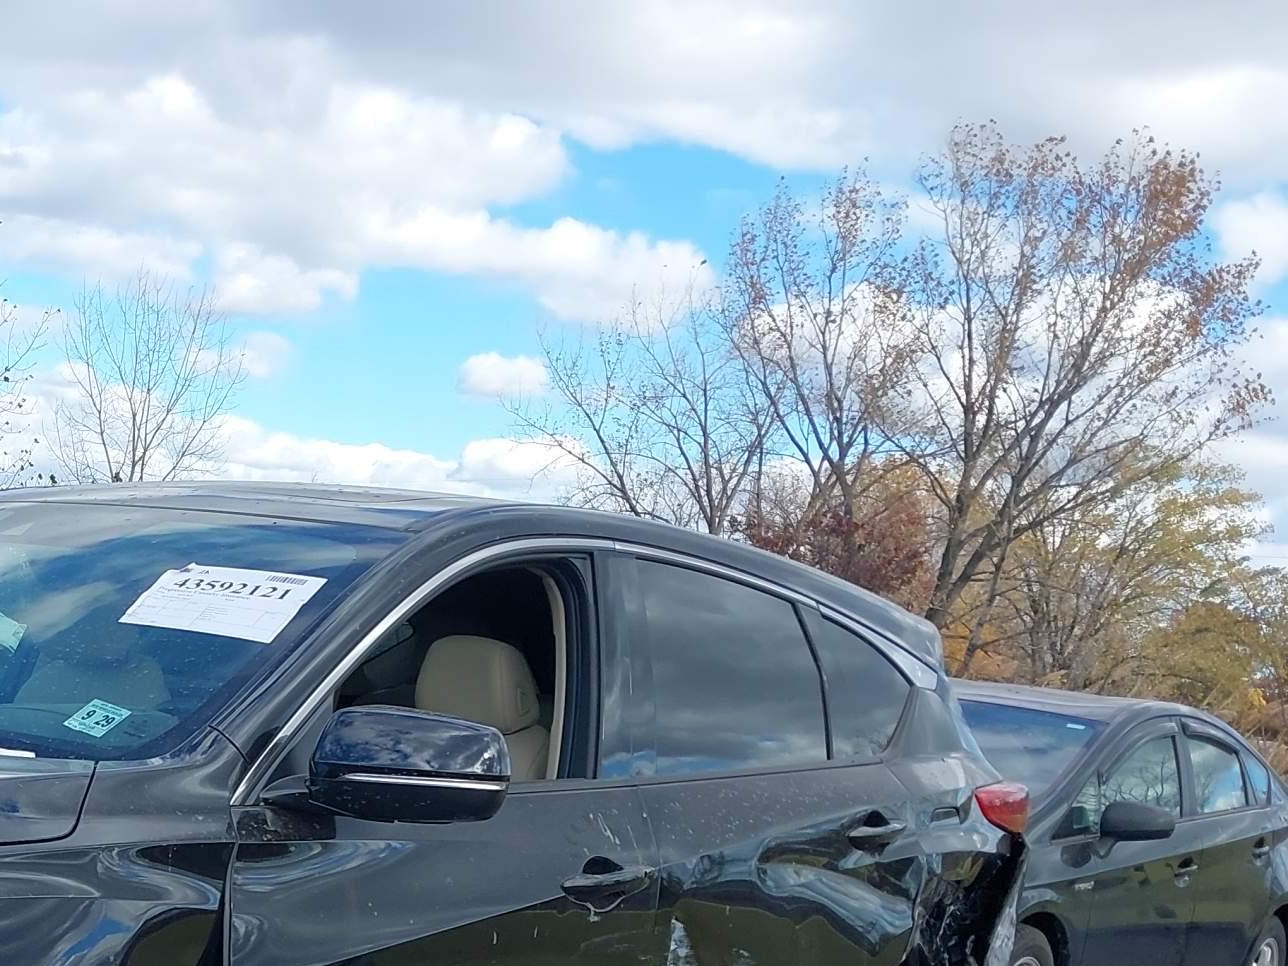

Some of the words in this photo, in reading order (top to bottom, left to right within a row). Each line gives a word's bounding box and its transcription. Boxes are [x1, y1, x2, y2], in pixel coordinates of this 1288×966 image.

[173, 577, 292, 600] 43592121
[81, 709, 97, 721] 9
[93, 714, 116, 728] 29
